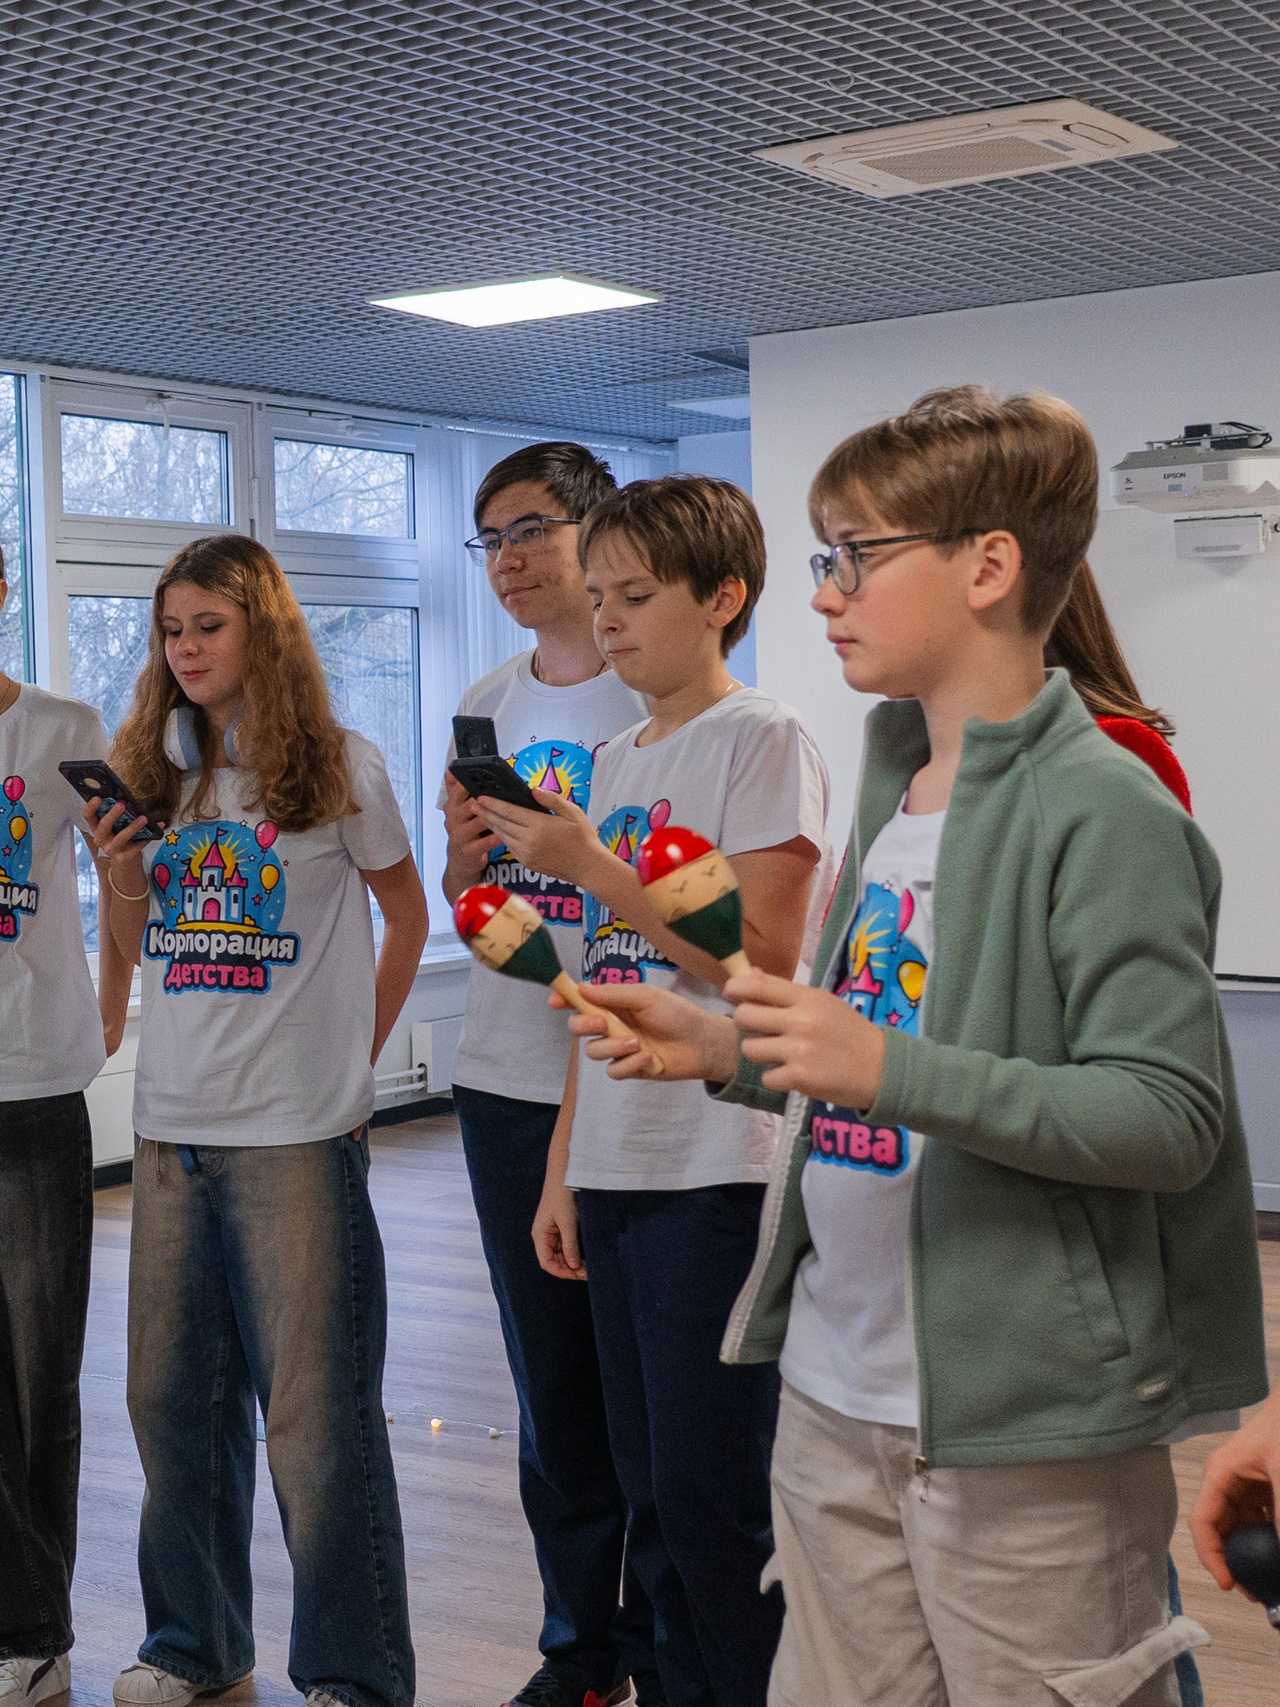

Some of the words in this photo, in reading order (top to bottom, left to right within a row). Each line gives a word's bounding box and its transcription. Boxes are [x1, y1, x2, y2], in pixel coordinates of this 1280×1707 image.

[1163, 472, 1187, 480] EPSON
[149, 926, 295, 960] Корпорация
[166, 963, 265, 988] детства
